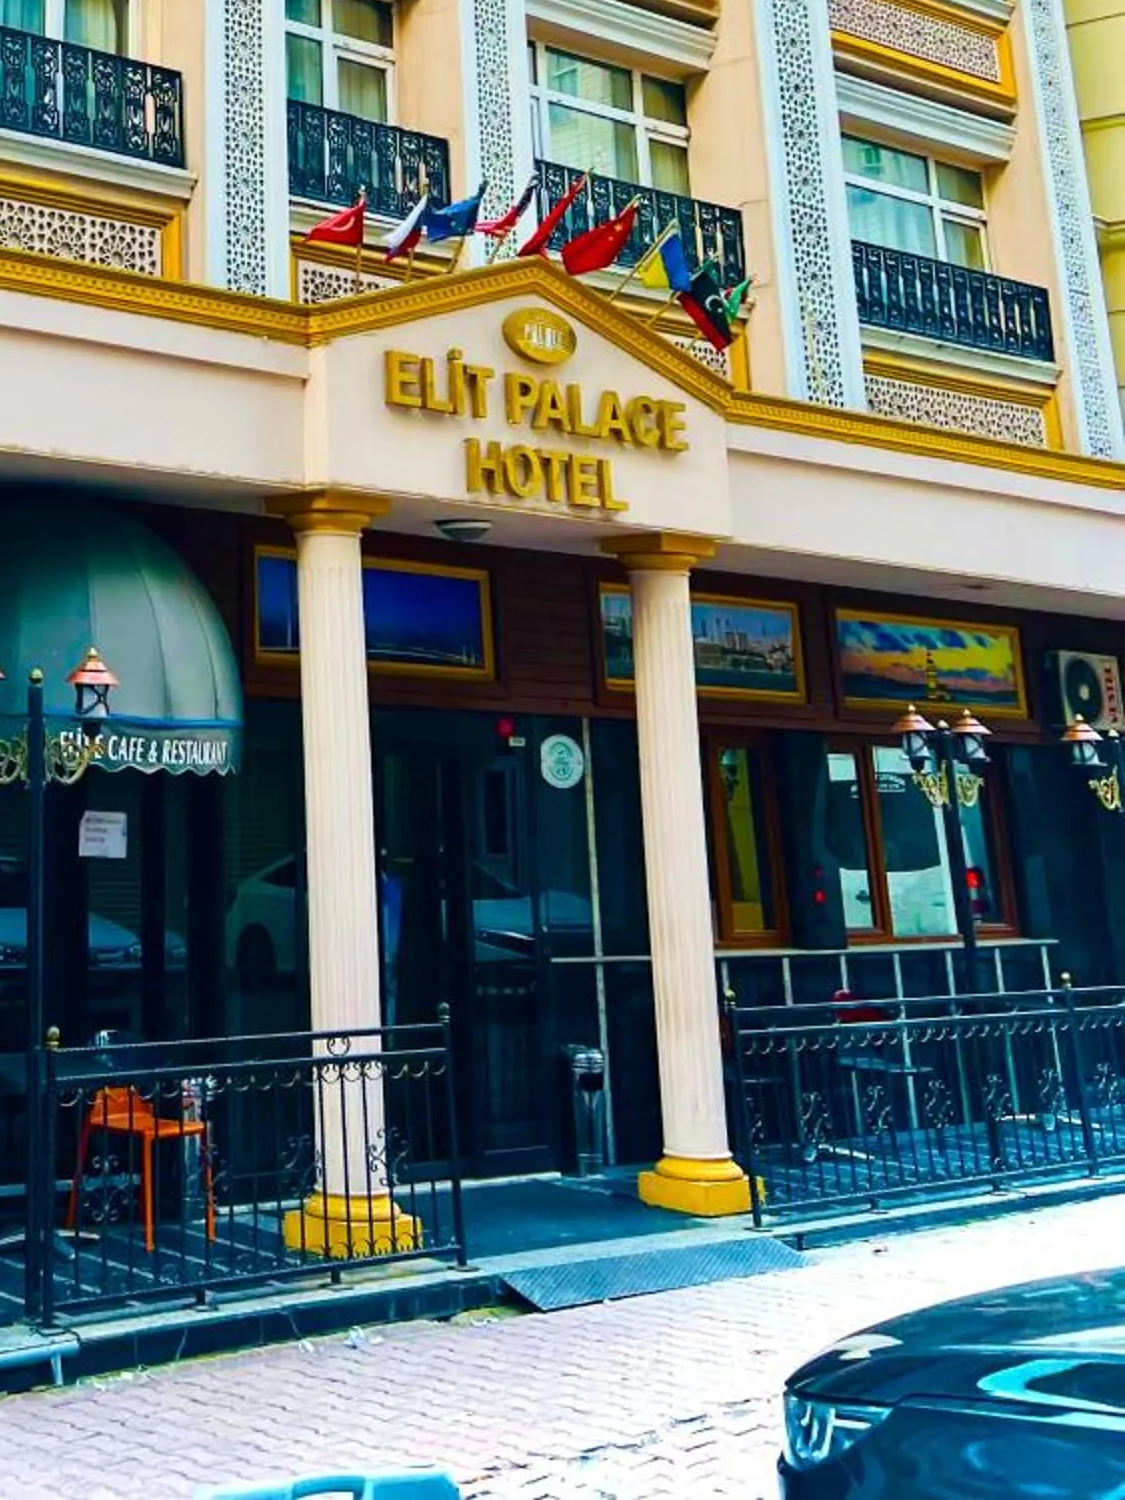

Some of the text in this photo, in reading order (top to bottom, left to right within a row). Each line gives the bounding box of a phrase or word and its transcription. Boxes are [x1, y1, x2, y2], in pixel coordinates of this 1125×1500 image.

[385, 347, 689, 452] ELİT PALACE
[464, 437, 629, 512] HOTEL
[108, 735, 146, 762] CAFE
[147, 738, 158, 763] &
[162, 739, 228, 765] RESTAURANT
